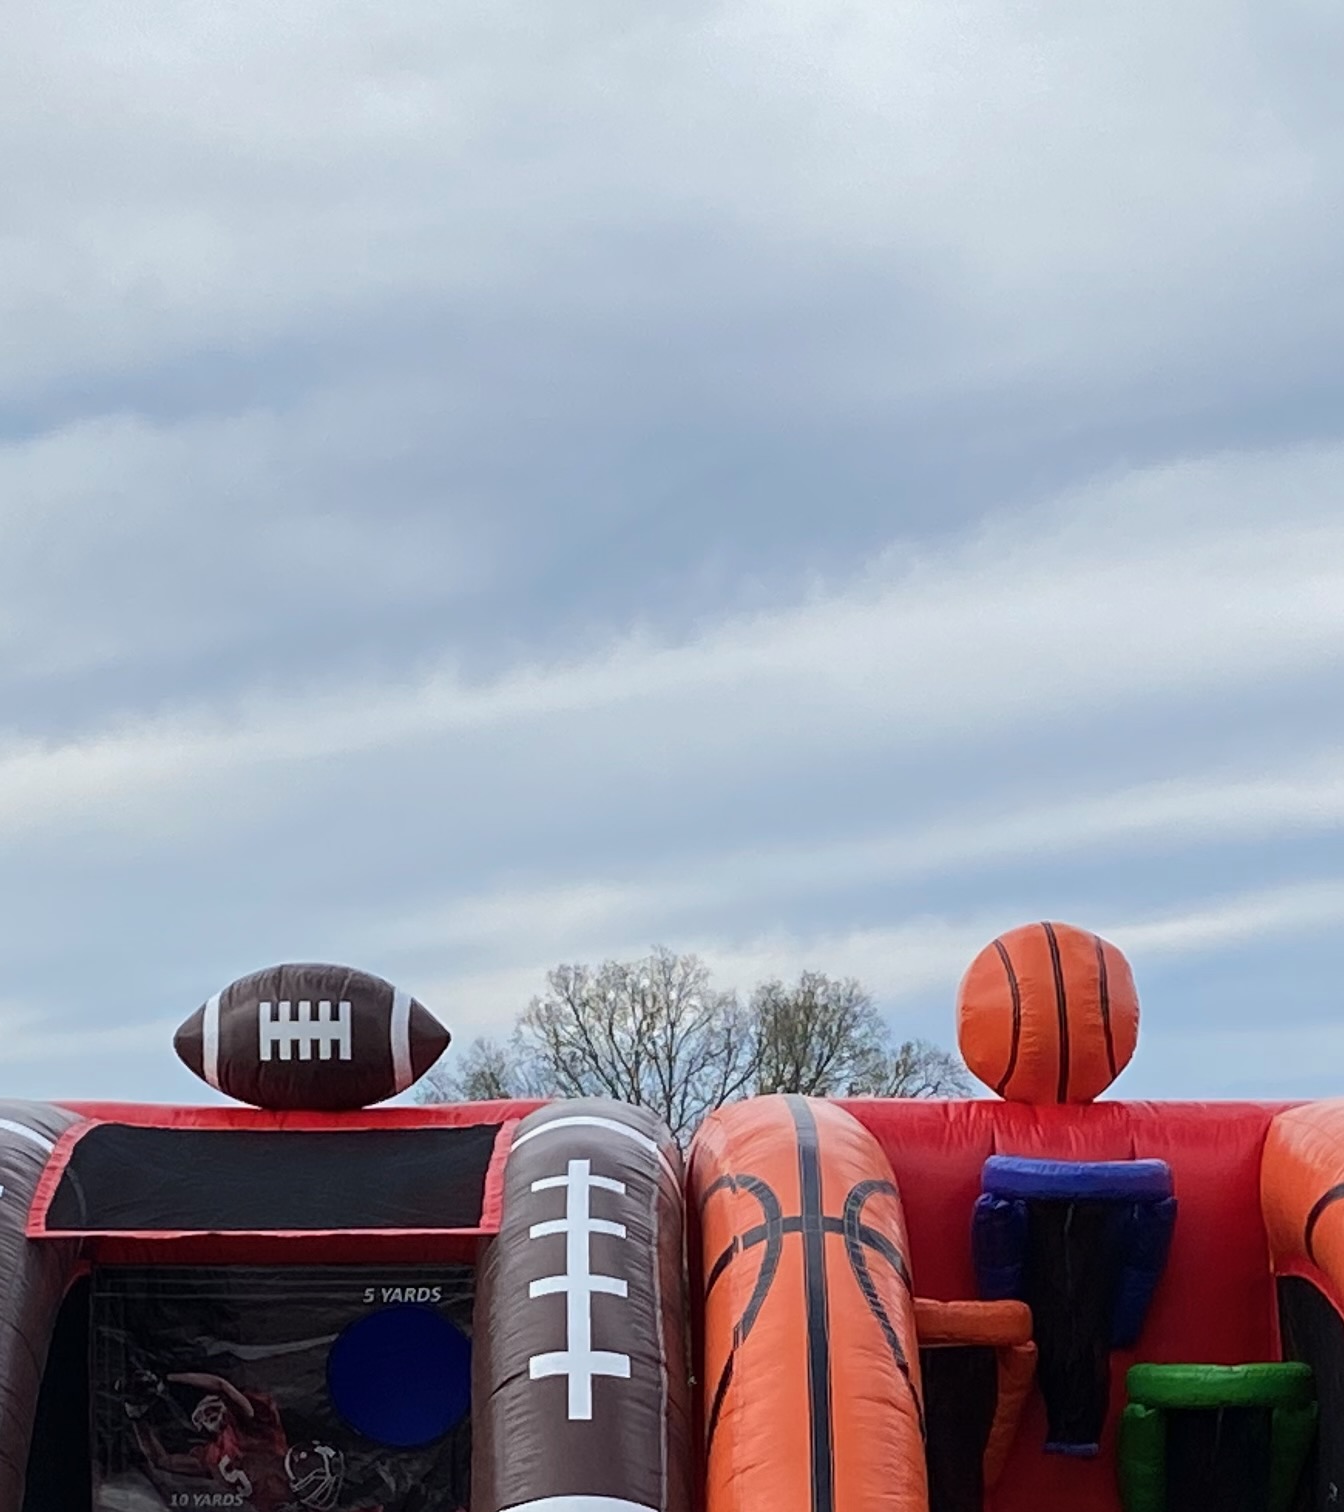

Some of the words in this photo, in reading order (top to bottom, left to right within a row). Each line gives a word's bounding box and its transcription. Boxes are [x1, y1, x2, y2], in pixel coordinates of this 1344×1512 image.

[362, 1287, 375, 1303] 5
[381, 1286, 442, 1303] YARDS
[170, 1494, 190, 1507] 10
[192, 1493, 244, 1507] YARDS
